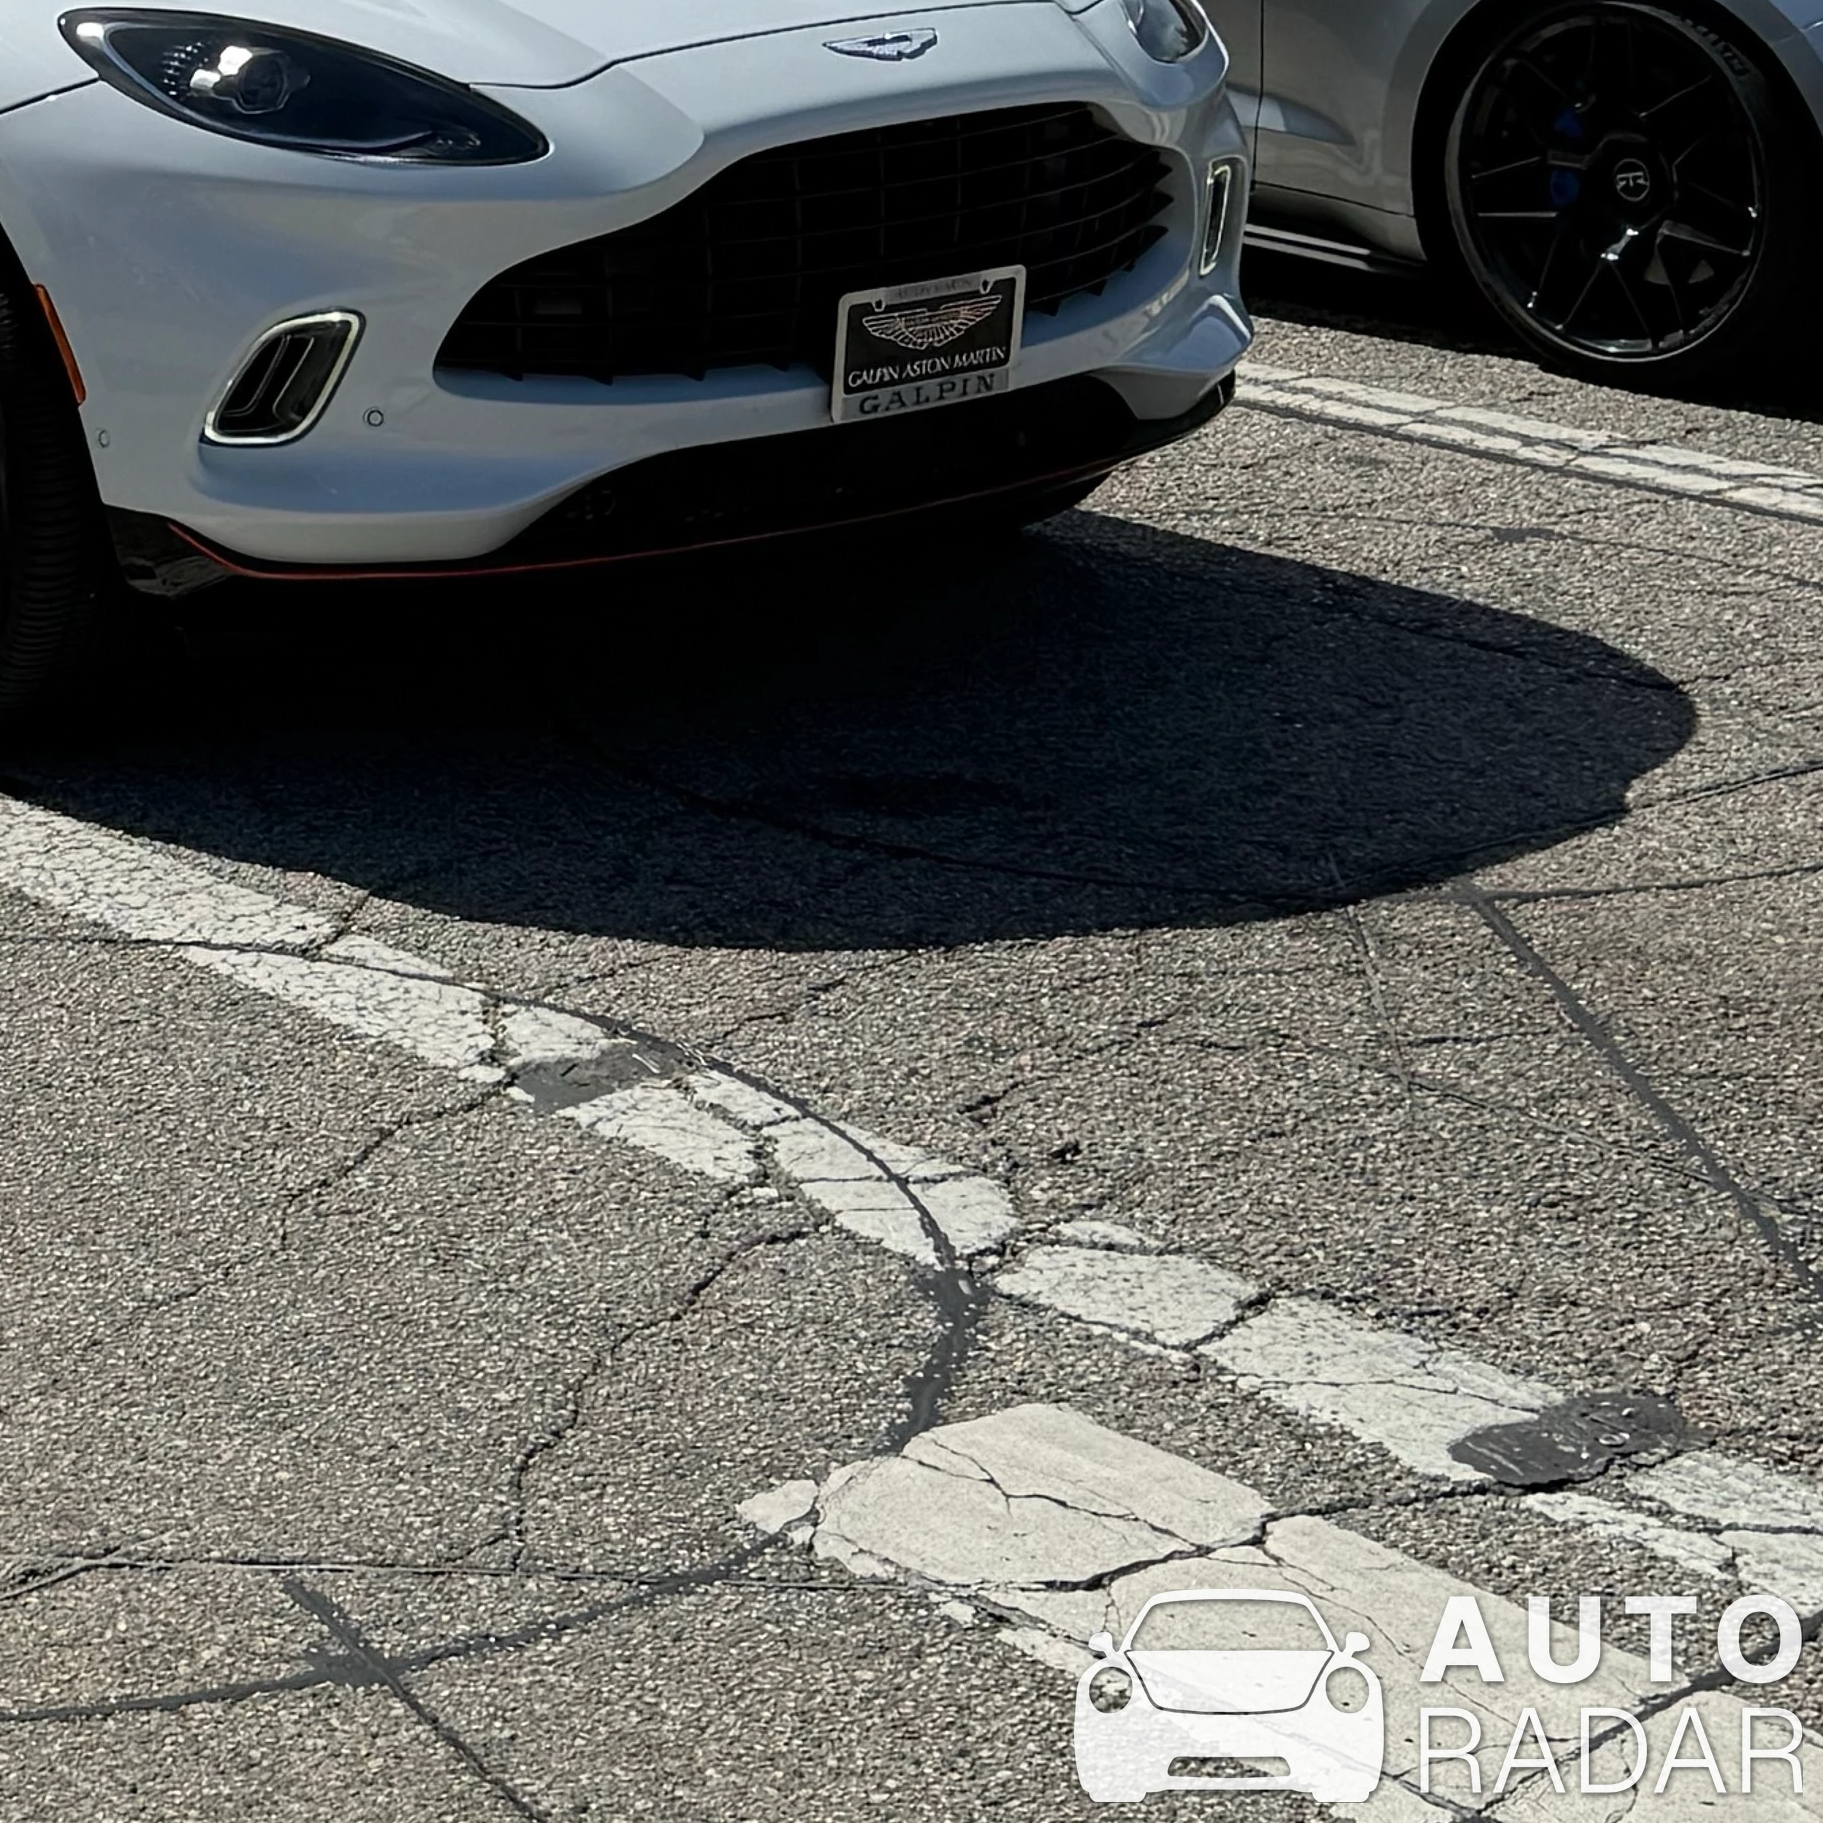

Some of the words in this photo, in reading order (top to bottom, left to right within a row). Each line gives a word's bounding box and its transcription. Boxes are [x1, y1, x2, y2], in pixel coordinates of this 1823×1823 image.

[848, 365, 900, 387] GALPIN
[902, 355, 951, 378] ASTON
[953, 346, 1006, 369] MARTIN
[859, 373, 995, 415] GALPIN
